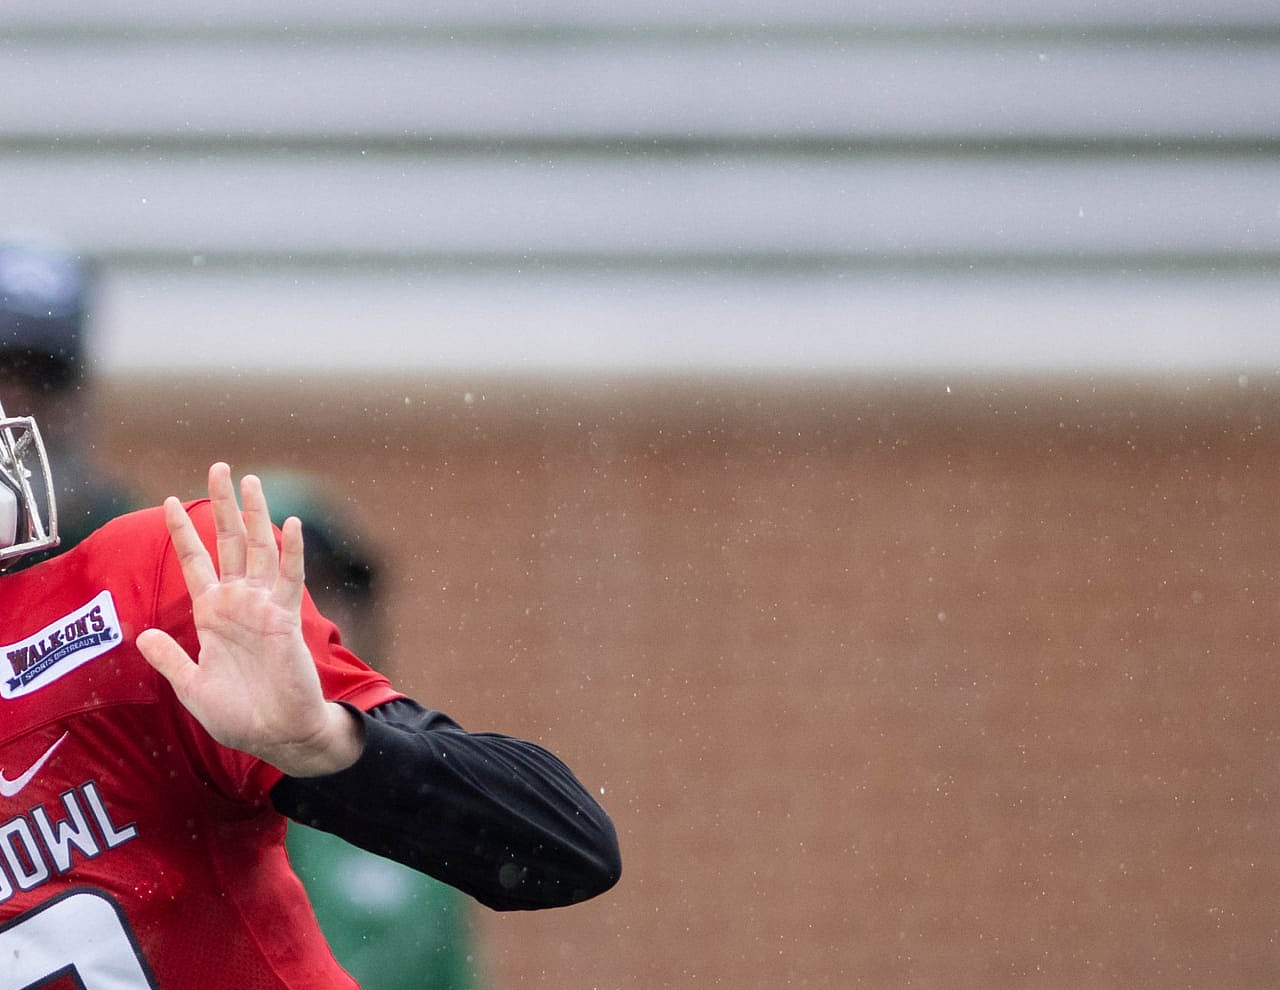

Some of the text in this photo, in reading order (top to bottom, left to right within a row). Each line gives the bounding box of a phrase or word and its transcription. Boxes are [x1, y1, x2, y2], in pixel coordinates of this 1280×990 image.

[6, 605, 106, 677] WALK-ON'S
[25, 637, 96, 681] SPORTS DISTREAUX
